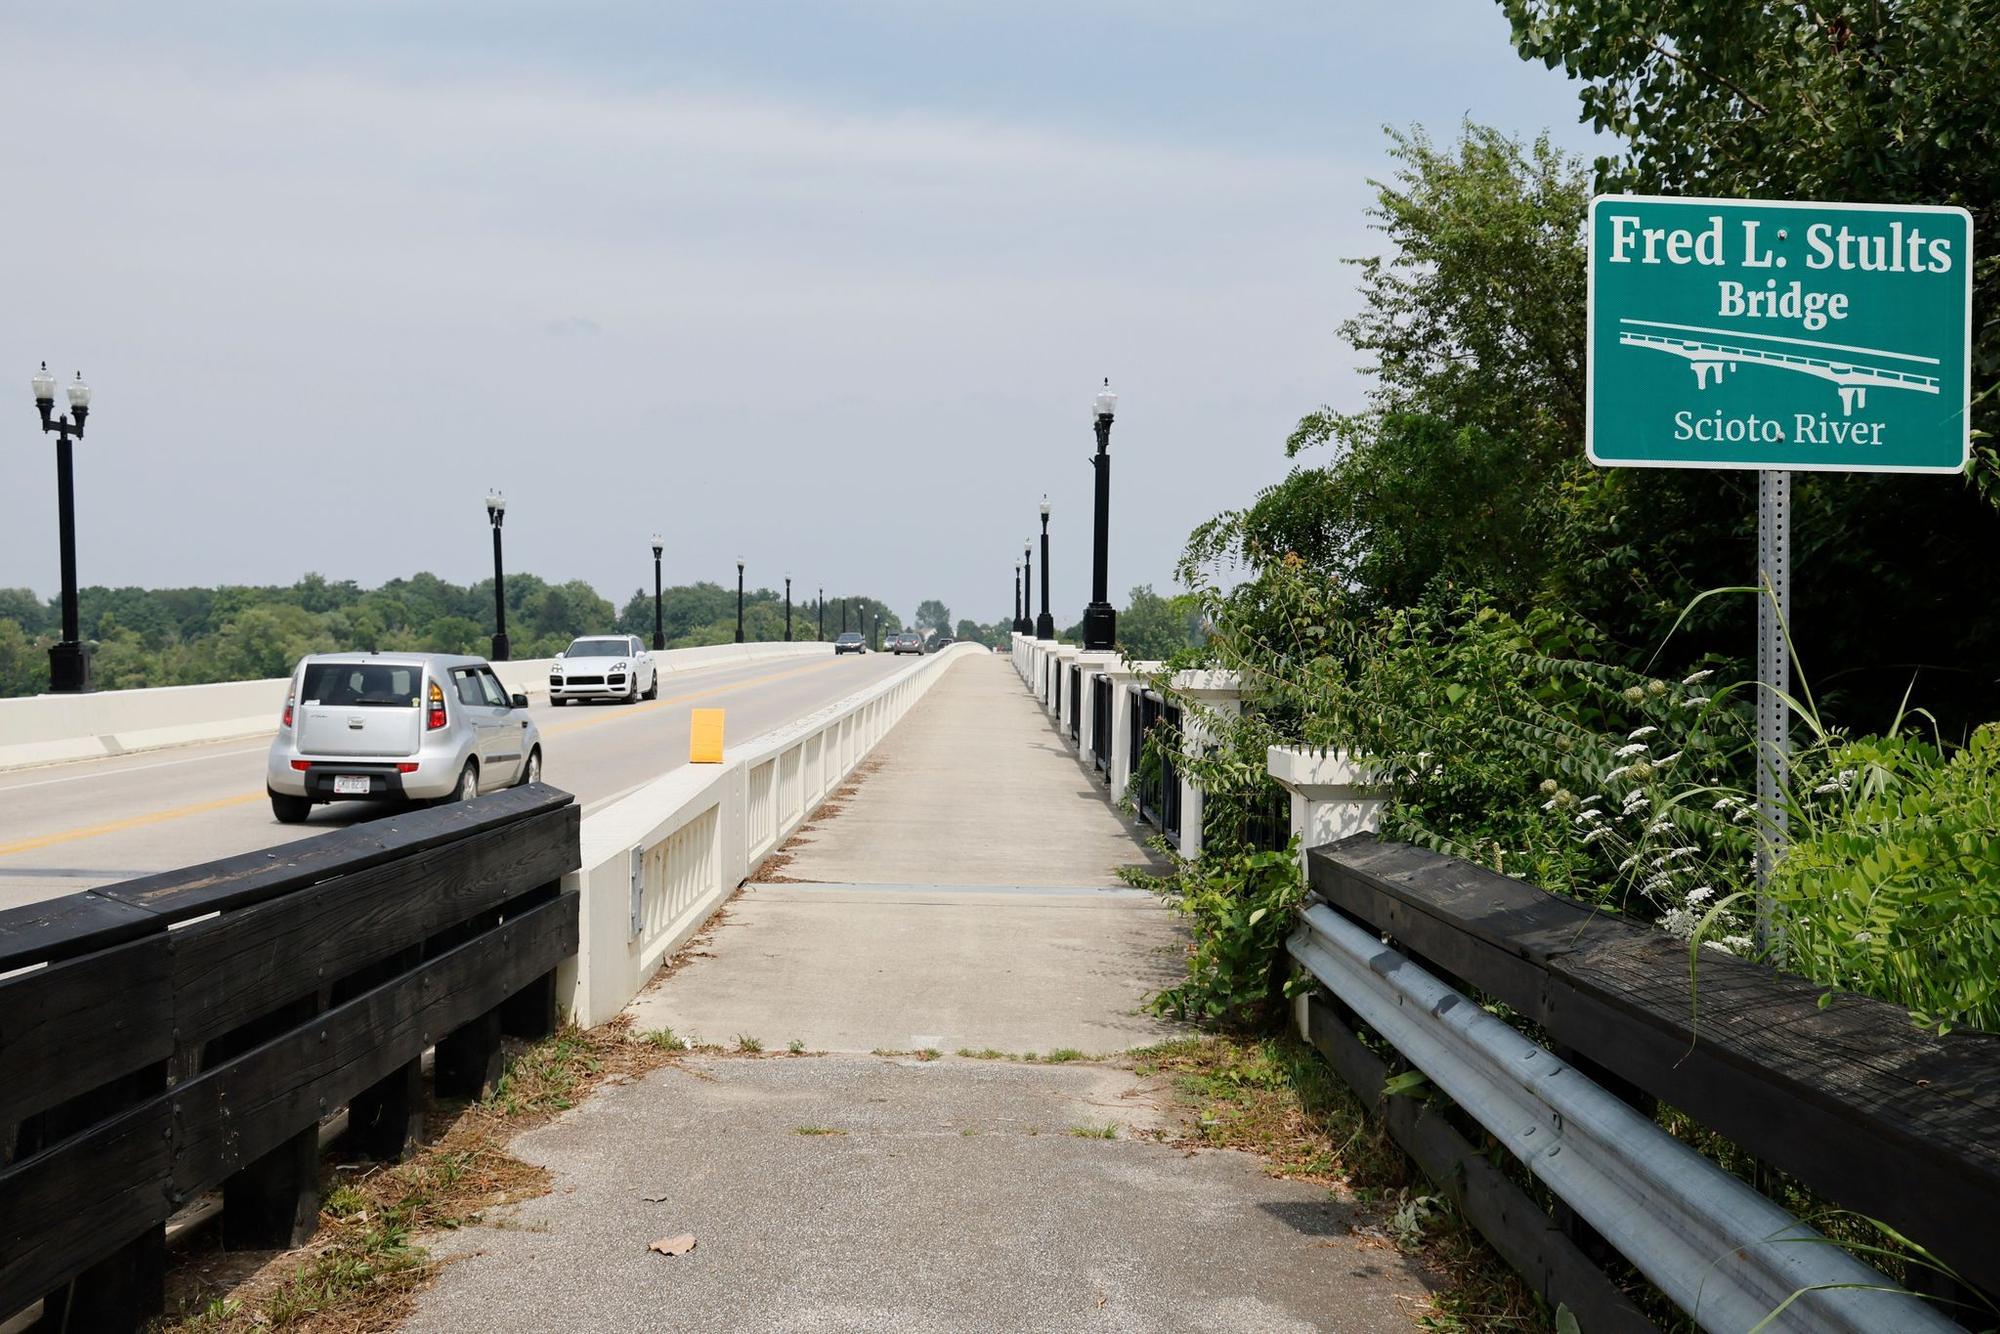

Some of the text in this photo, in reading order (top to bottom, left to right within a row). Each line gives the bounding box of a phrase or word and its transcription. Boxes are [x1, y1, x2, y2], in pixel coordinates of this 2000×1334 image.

[1609, 215, 1952, 273] Fred L. Stults
[1718, 279, 1849, 331] Bridge
[1674, 410, 1886, 445] Scioto River
